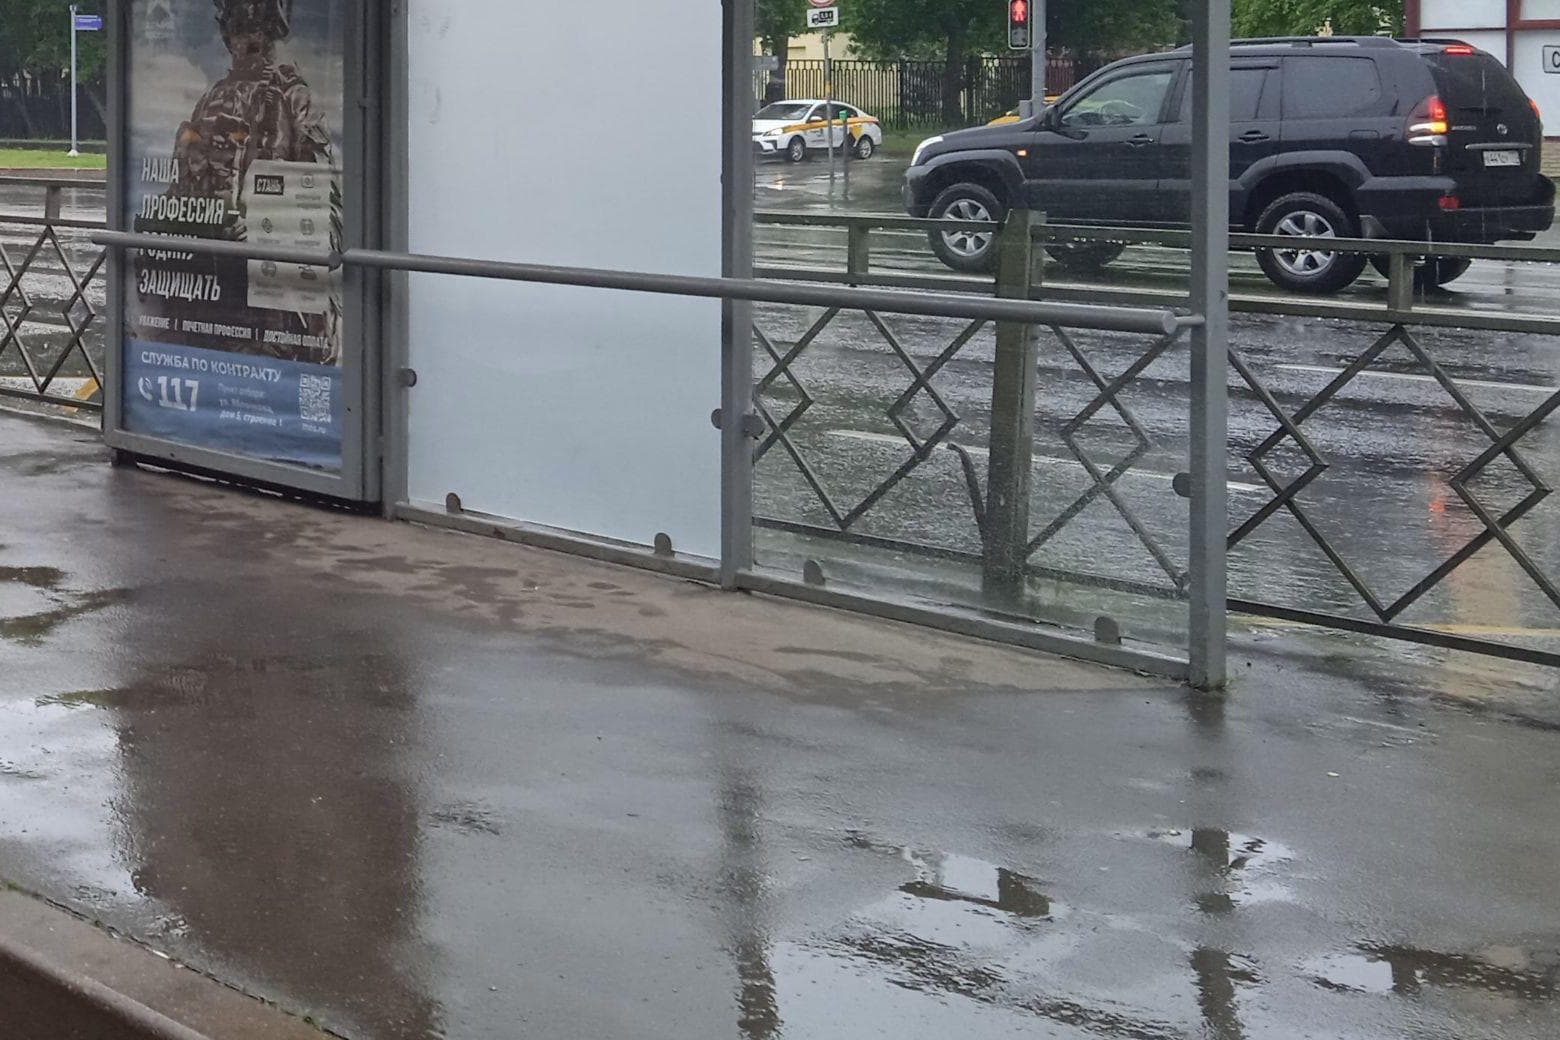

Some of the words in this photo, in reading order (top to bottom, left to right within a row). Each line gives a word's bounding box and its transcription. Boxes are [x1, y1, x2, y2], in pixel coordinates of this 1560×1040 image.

[141, 158, 179, 184] НАША
[141, 194, 225, 225] ПРОФЕССИЯ
[139, 269, 221, 302] ЗАЩИЩАТЬ
[141, 351, 189, 369] СЛУЖБА
[191, 357, 207, 371] ПО
[210, 361, 282, 382] КОНТРАКТУ
[157, 375, 200, 412] 117
